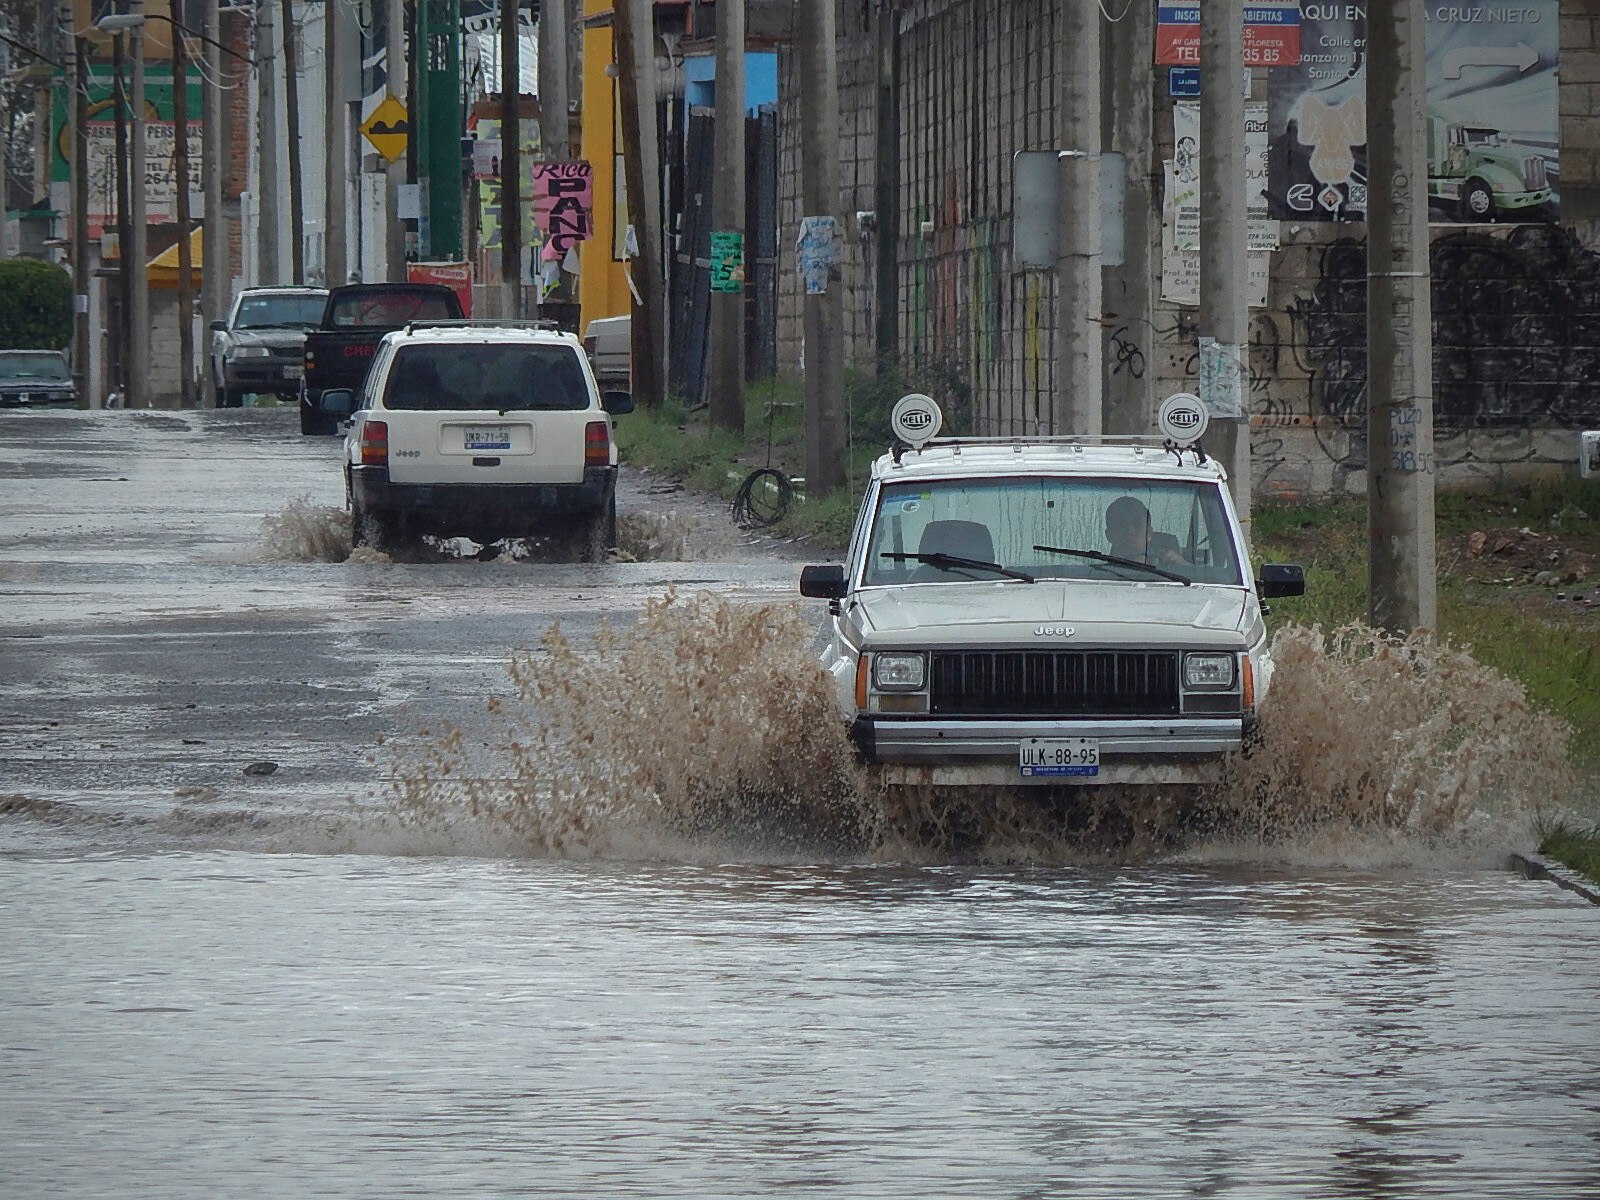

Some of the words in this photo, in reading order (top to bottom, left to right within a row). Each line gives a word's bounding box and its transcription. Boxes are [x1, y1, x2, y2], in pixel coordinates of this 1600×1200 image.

[1243, 11, 1282, 21] ABIERTAS
[1436, 7, 1483, 22] CRUZ
[1487, 8, 1541, 23] NIETO
[1320, 35, 1351, 47] Calle
[1243, 48, 1260, 62] 35
[1263, 49, 1280, 62] 85
[1308, 66, 1344, 81] Santa
[534, 164, 592, 179] Rica
[901, 412, 933, 426] HELLA
[1168, 411, 1200, 425] HELLA
[395, 449, 421, 458] Jeep
[1034, 626, 1075, 637] Jeep
[1022, 748, 1097, 766] ULK-88-95
